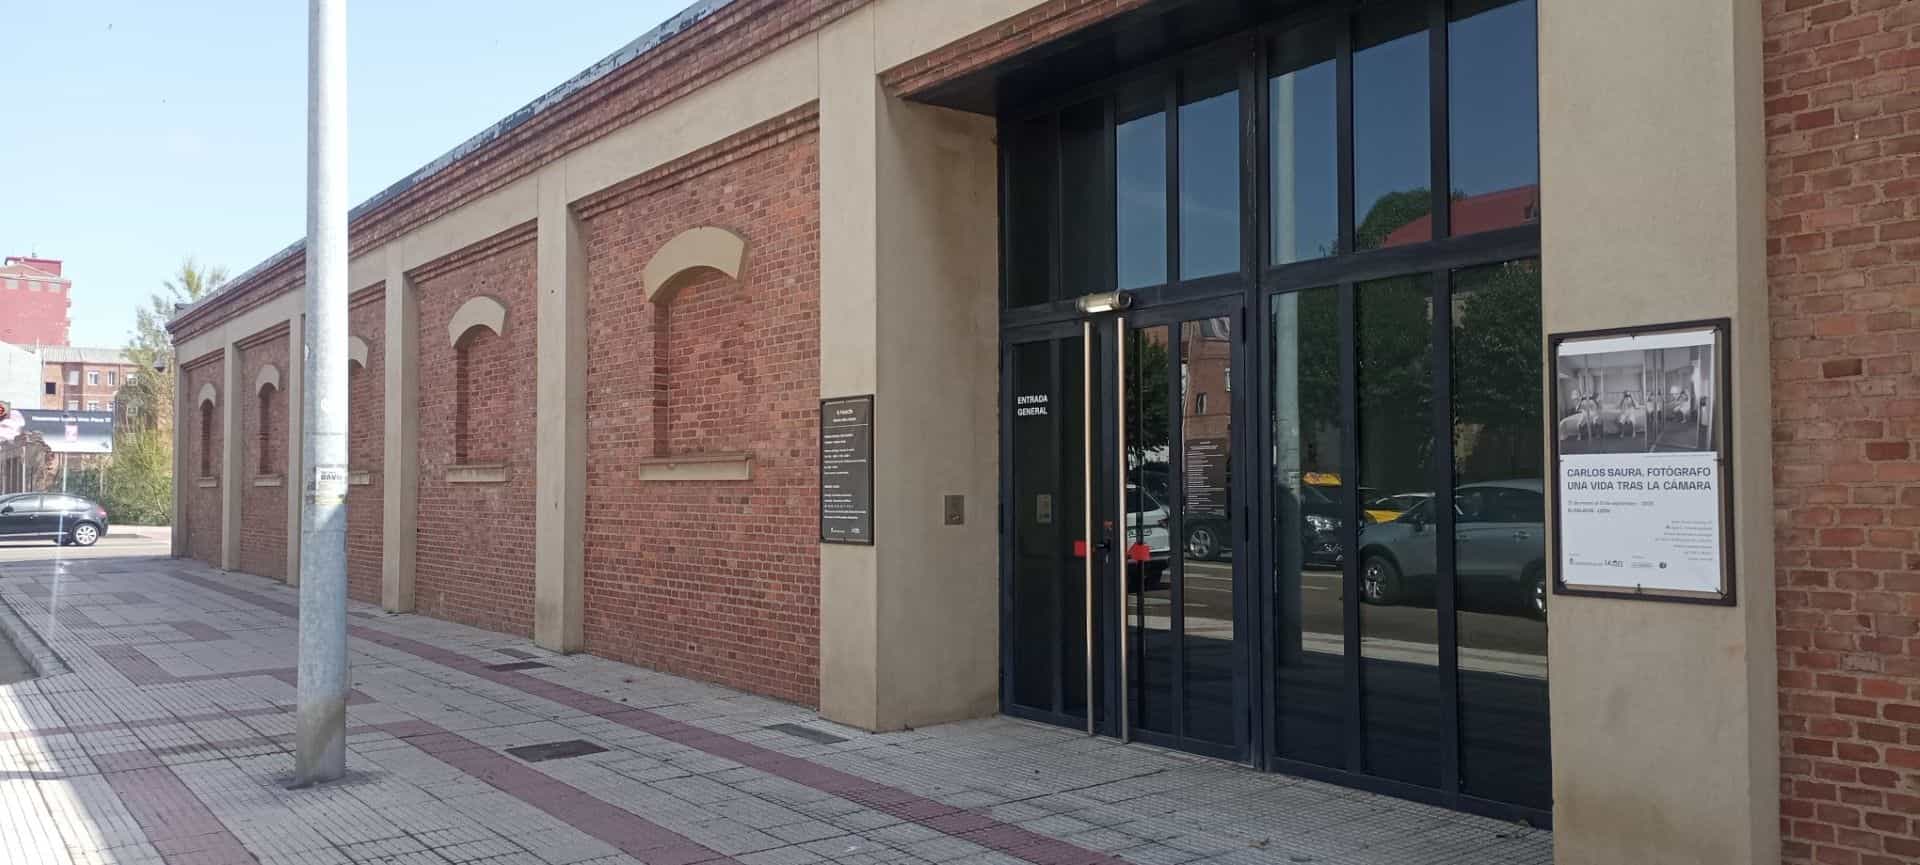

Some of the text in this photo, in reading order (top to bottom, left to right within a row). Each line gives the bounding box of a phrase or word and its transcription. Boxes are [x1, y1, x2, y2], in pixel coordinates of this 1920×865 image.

[1017, 394, 1048, 405] ENTRADA
[1017, 406, 1048, 417] GENERAL
[1567, 465, 1711, 478] CARLOS SAURA, FOTÓGRAFO
[1567, 480, 1588, 491] UNA
[1590, 480, 1614, 491] VIDA
[1617, 480, 1644, 491] TRAS
[1647, 480, 1660, 491] LA
